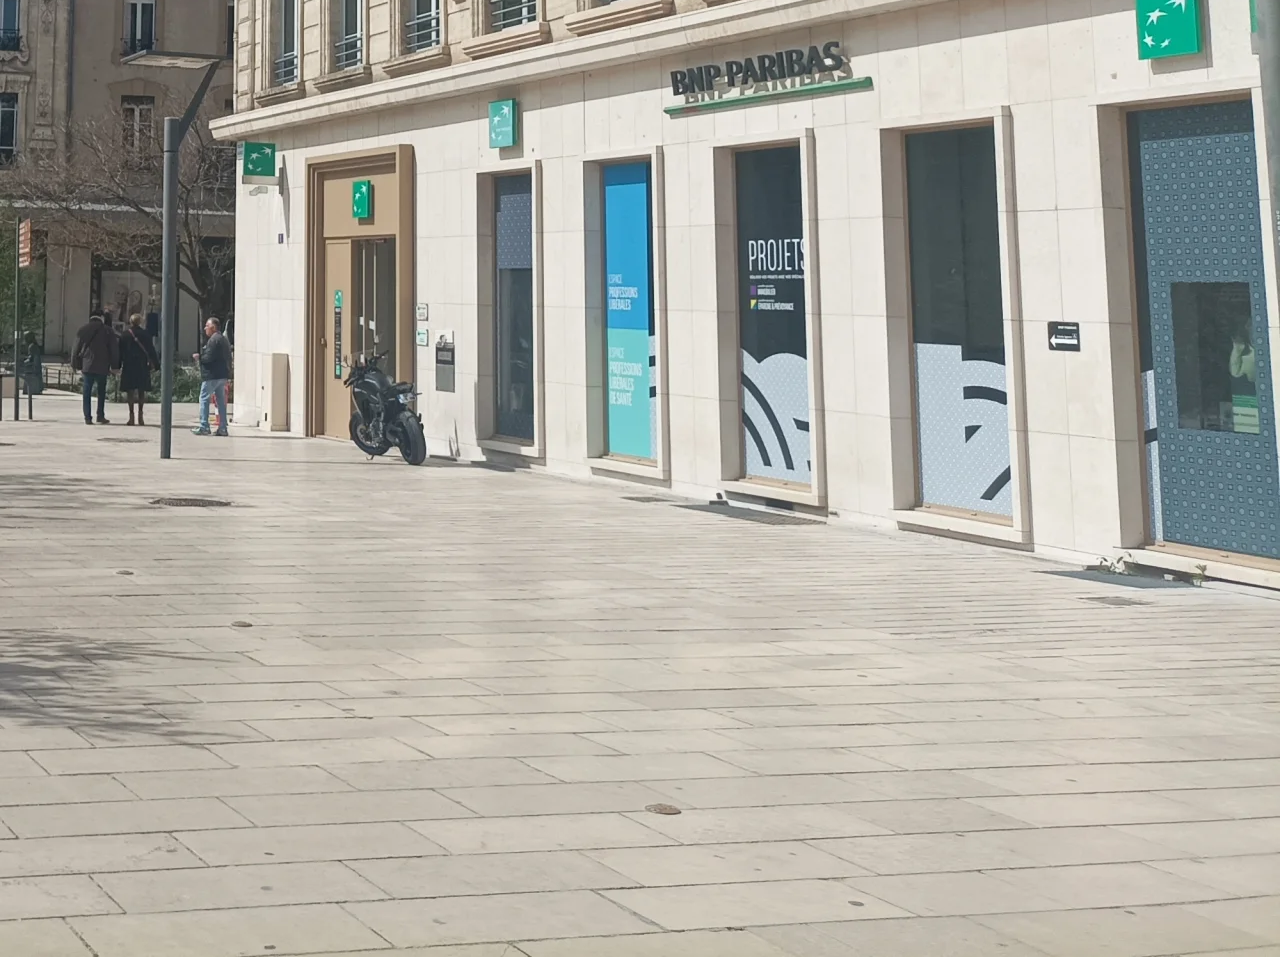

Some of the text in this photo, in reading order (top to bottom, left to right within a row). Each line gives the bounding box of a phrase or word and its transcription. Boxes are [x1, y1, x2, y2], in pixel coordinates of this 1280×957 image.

[670, 41, 843, 96] BNP PARIBAS
[608, 287, 638, 298] PROFESSIONS
[609, 361, 642, 377] PROFESSIONS
